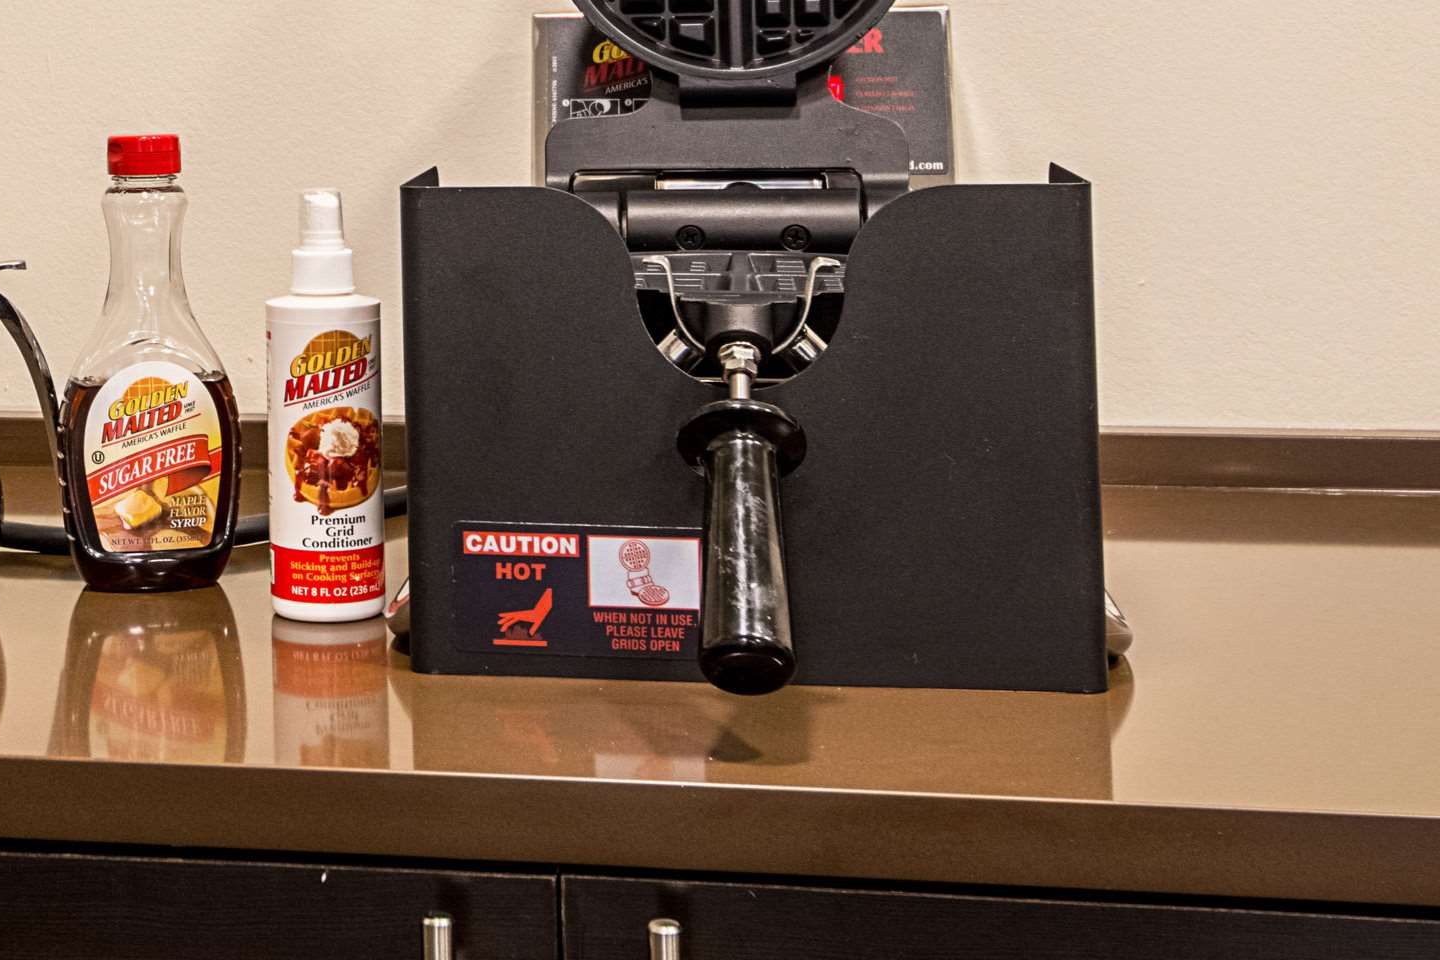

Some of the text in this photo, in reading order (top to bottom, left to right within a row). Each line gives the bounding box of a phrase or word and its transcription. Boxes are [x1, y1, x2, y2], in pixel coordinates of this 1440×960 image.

[289, 334, 372, 379] GOLDEN
[284, 357, 368, 403] MALTED
[108, 380, 190, 421] GOLDEN
[302, 392, 344, 410] AMERICA'S
[101, 400, 183, 444] MALTED
[121, 422, 187, 449] AMERICA'S WAFFLE
[98, 442, 196, 495] SUGAR FREE
[170, 495, 207, 506] MAPLE
[170, 506, 207, 517] FLAVOR
[170, 517, 207, 529] SYRUP
[311, 514, 366, 526] Premium
[326, 525, 354, 537] Grid
[302, 536, 372, 548] Conditioner
[465, 534, 577, 555] CAUTION
[319, 553, 360, 563] Prevents
[290, 561, 327, 573] Sticking
[329, 563, 348, 571] and
[495, 562, 547, 581] HOT
[306, 572, 347, 582] Cooking
[291, 586, 309, 595] NET
[311, 587, 317, 596] 8
[320, 587, 331, 596] FL
[333, 587, 348, 596] OZ
[593, 611, 627, 623] WHEN
[630, 613, 652, 624] NOT
[655, 614, 668, 625] IN
[606, 626, 685, 639] PLEASE LEAVE
[611, 638, 681, 652] GRIDS OPEN
